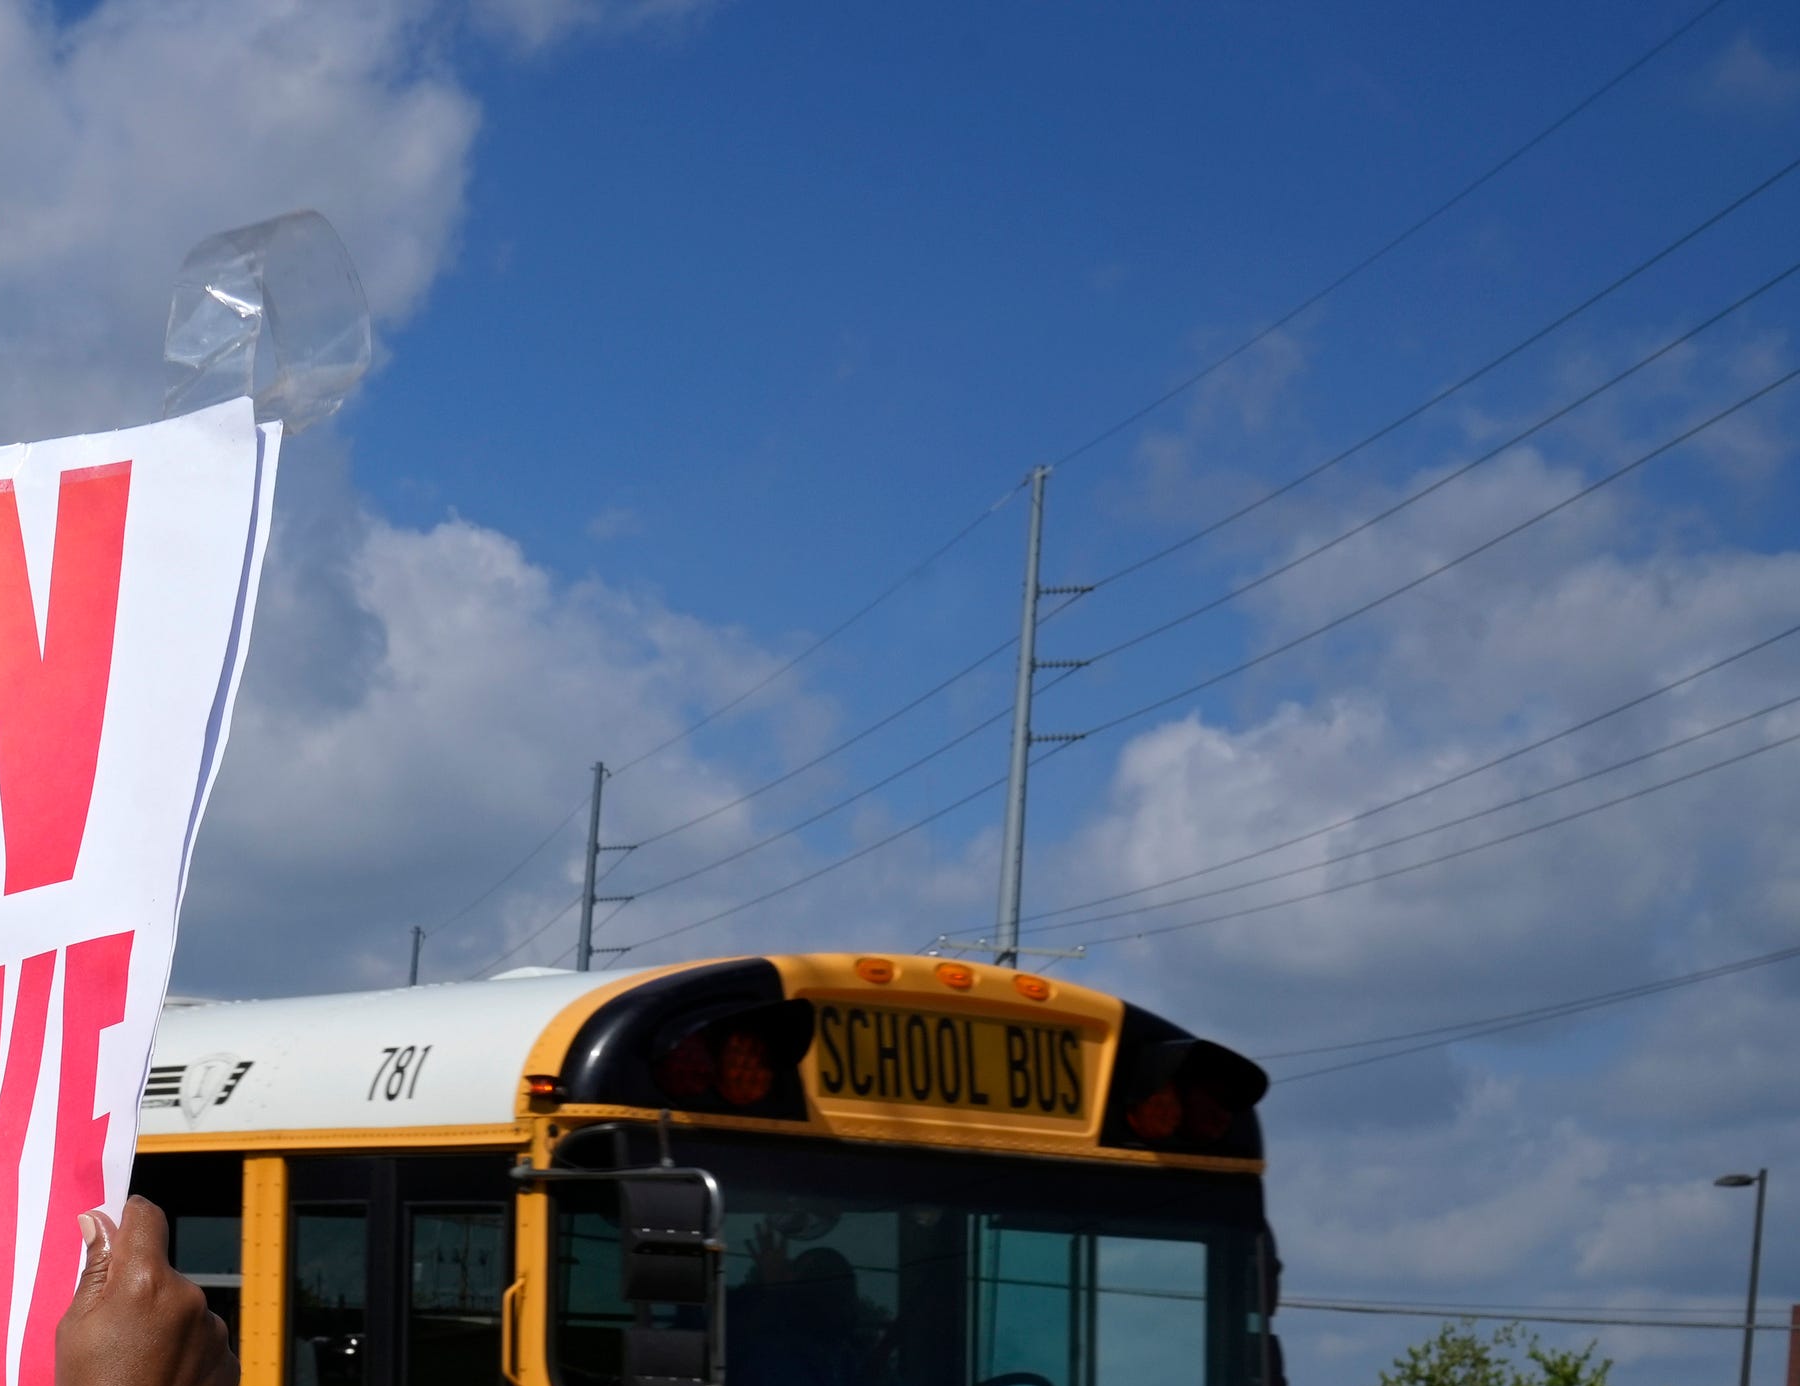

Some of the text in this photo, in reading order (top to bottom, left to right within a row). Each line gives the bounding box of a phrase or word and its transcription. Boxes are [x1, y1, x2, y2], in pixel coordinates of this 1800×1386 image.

[367, 1045, 432, 1101] 781
[820, 1005, 1081, 1114] SCHOOL BUS
